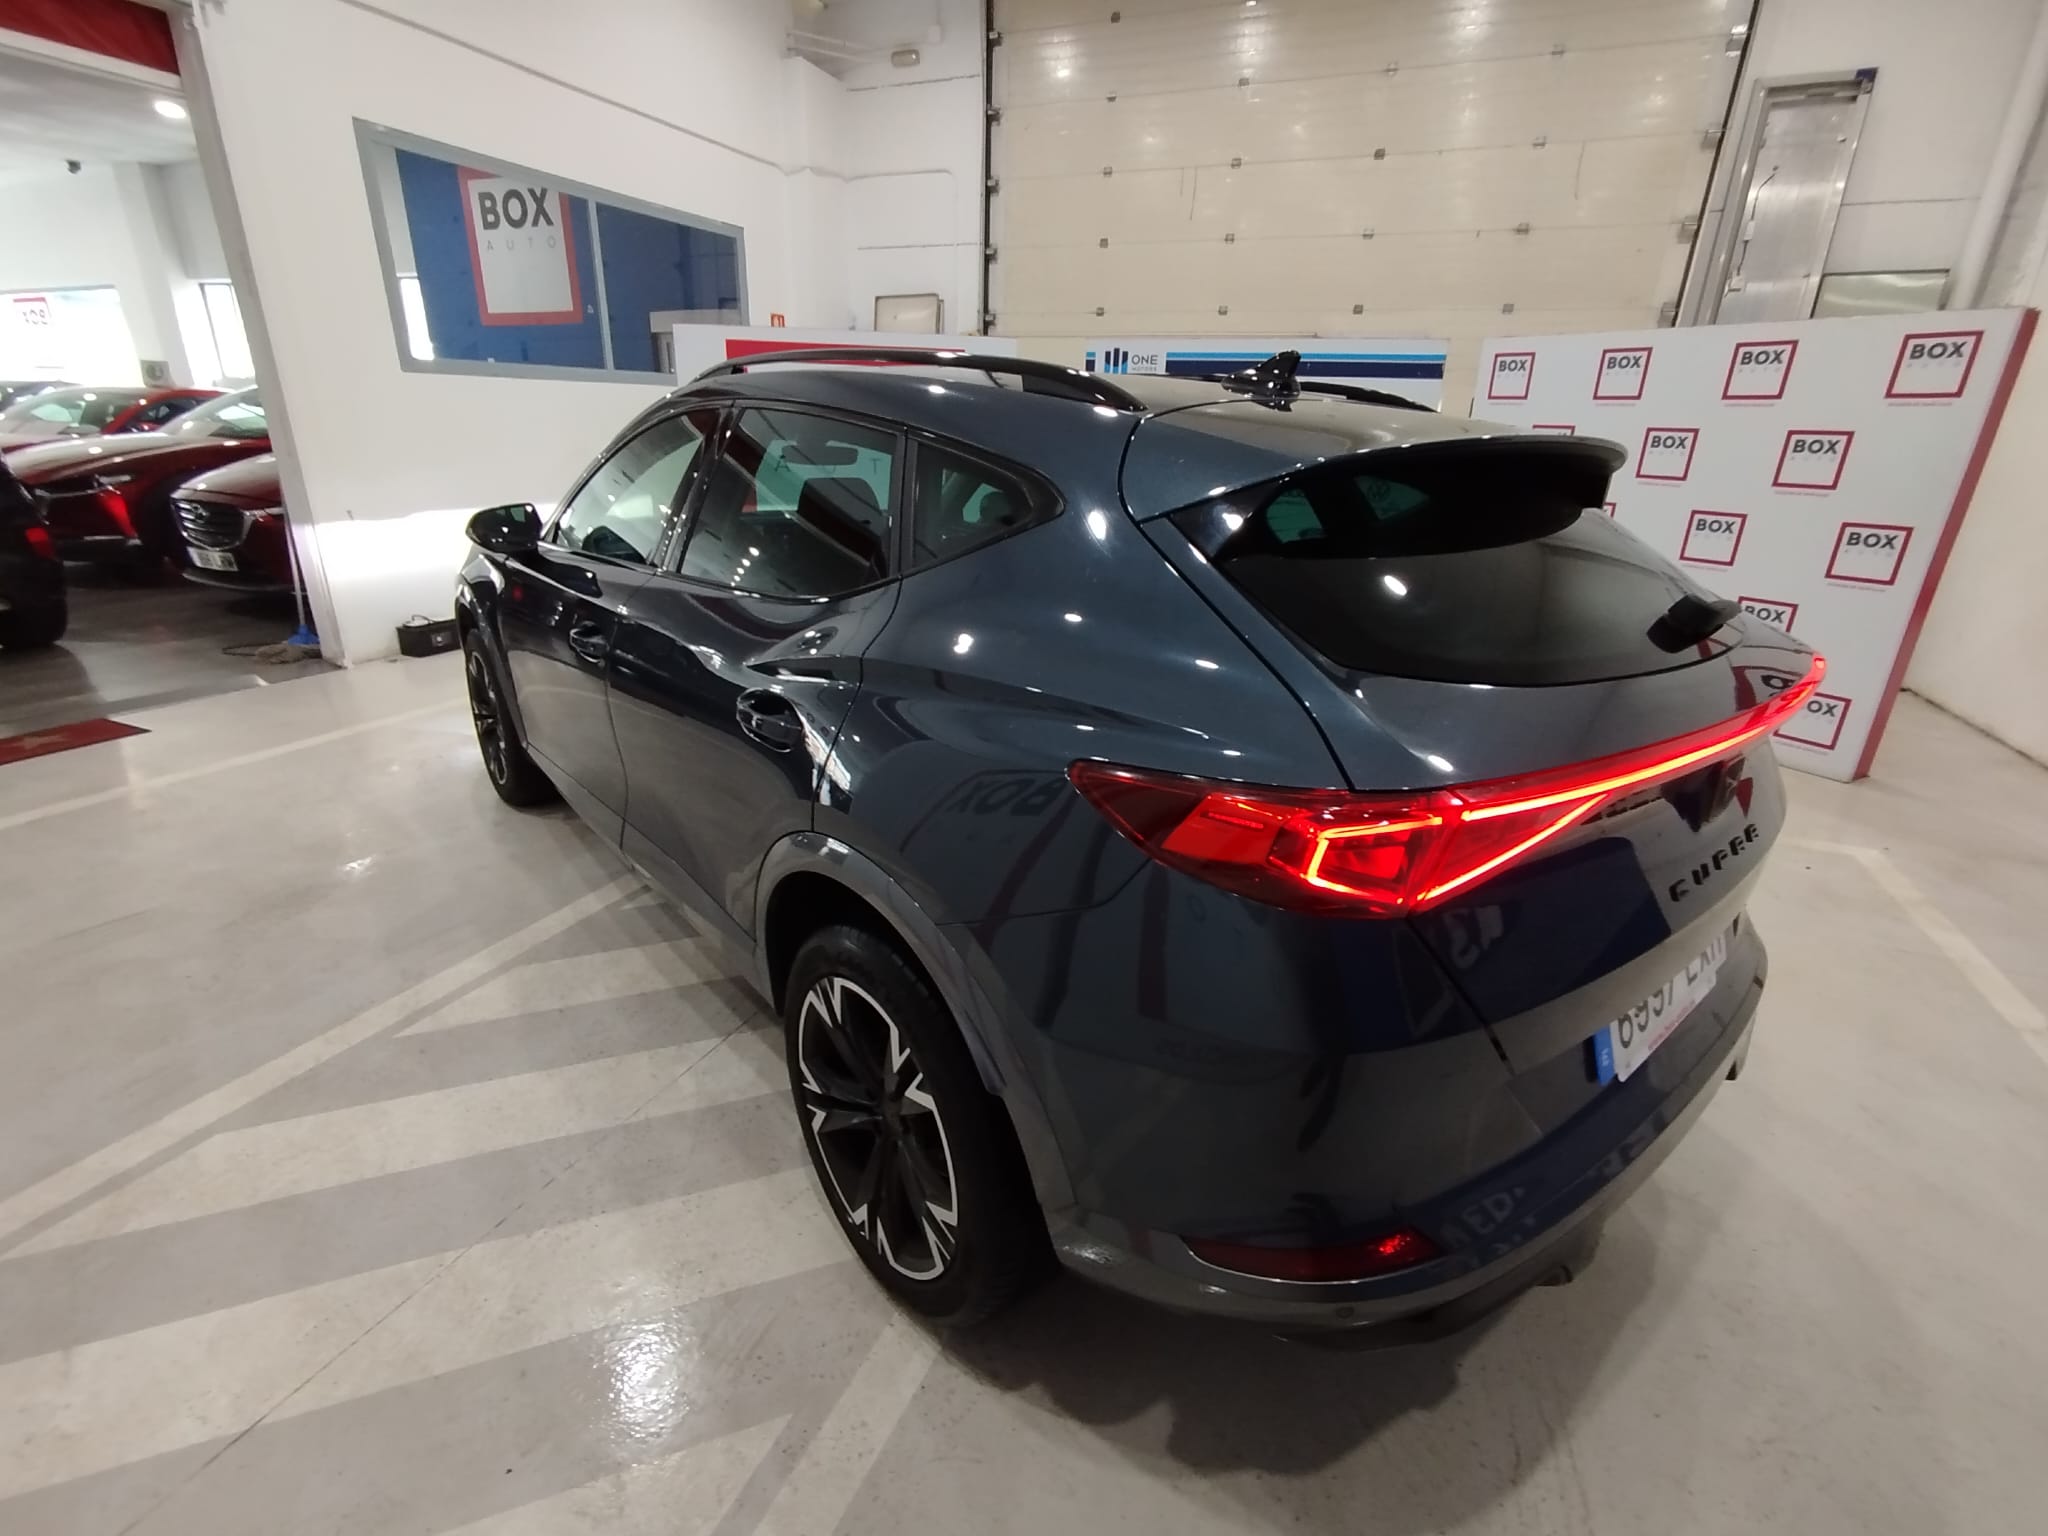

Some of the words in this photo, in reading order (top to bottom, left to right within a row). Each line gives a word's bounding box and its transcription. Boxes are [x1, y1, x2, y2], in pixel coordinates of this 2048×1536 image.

[478, 187, 554, 230] BOX
[487, 235, 557, 251] AUTO
[1740, 348, 1786, 366] BOX
[1909, 341, 1968, 360] BOX
[1131, 354, 1159, 366] ONE
[1498, 359, 1528, 372] BOX
[1606, 354, 1643, 370] BOX
[1650, 434, 1689, 451] BOX
[1791, 438, 1840, 456] BOX
[1695, 518, 1736, 535] BOX
[1846, 531, 1899, 552] BOX
[1807, 700, 1839, 717] OX
